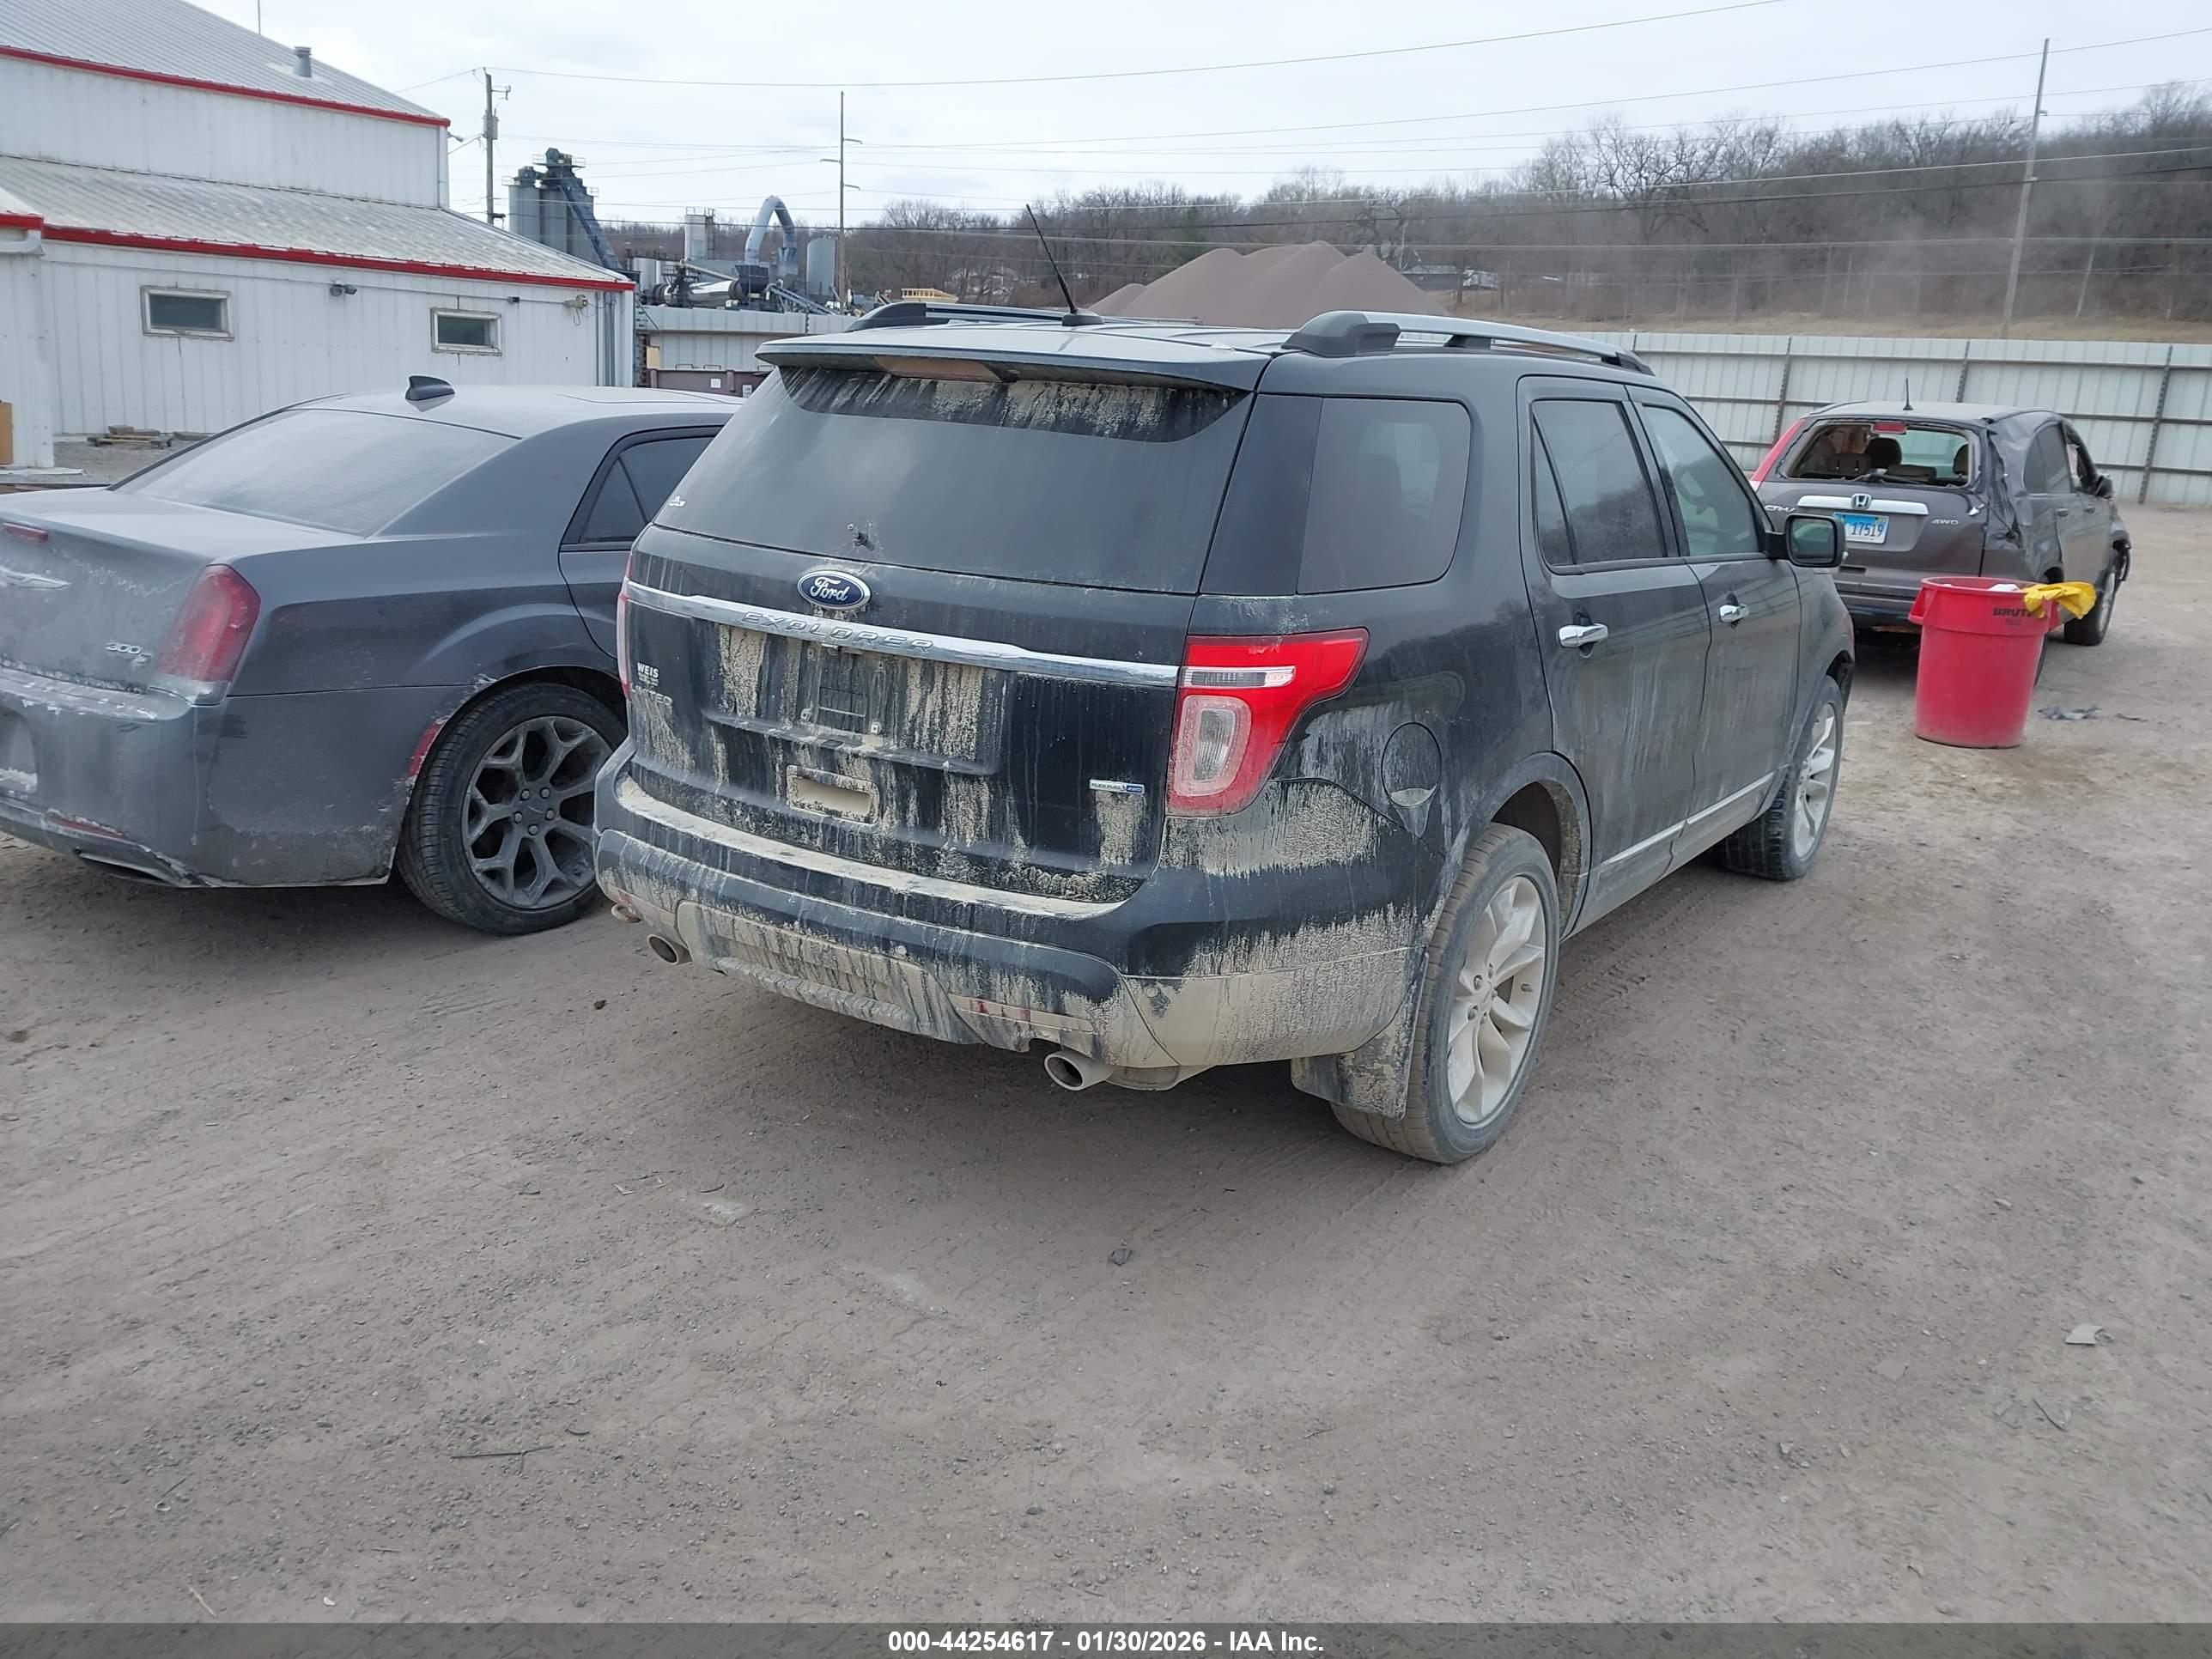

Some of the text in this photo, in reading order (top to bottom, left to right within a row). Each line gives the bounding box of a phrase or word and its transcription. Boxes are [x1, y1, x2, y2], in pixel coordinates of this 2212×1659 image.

[1850, 521, 1885, 538] 17519
[810, 576, 851, 601] Ford
[741, 611, 934, 653] EXPLORER
[106, 642, 142, 654] 300
[637, 661, 659, 678] WEIS
